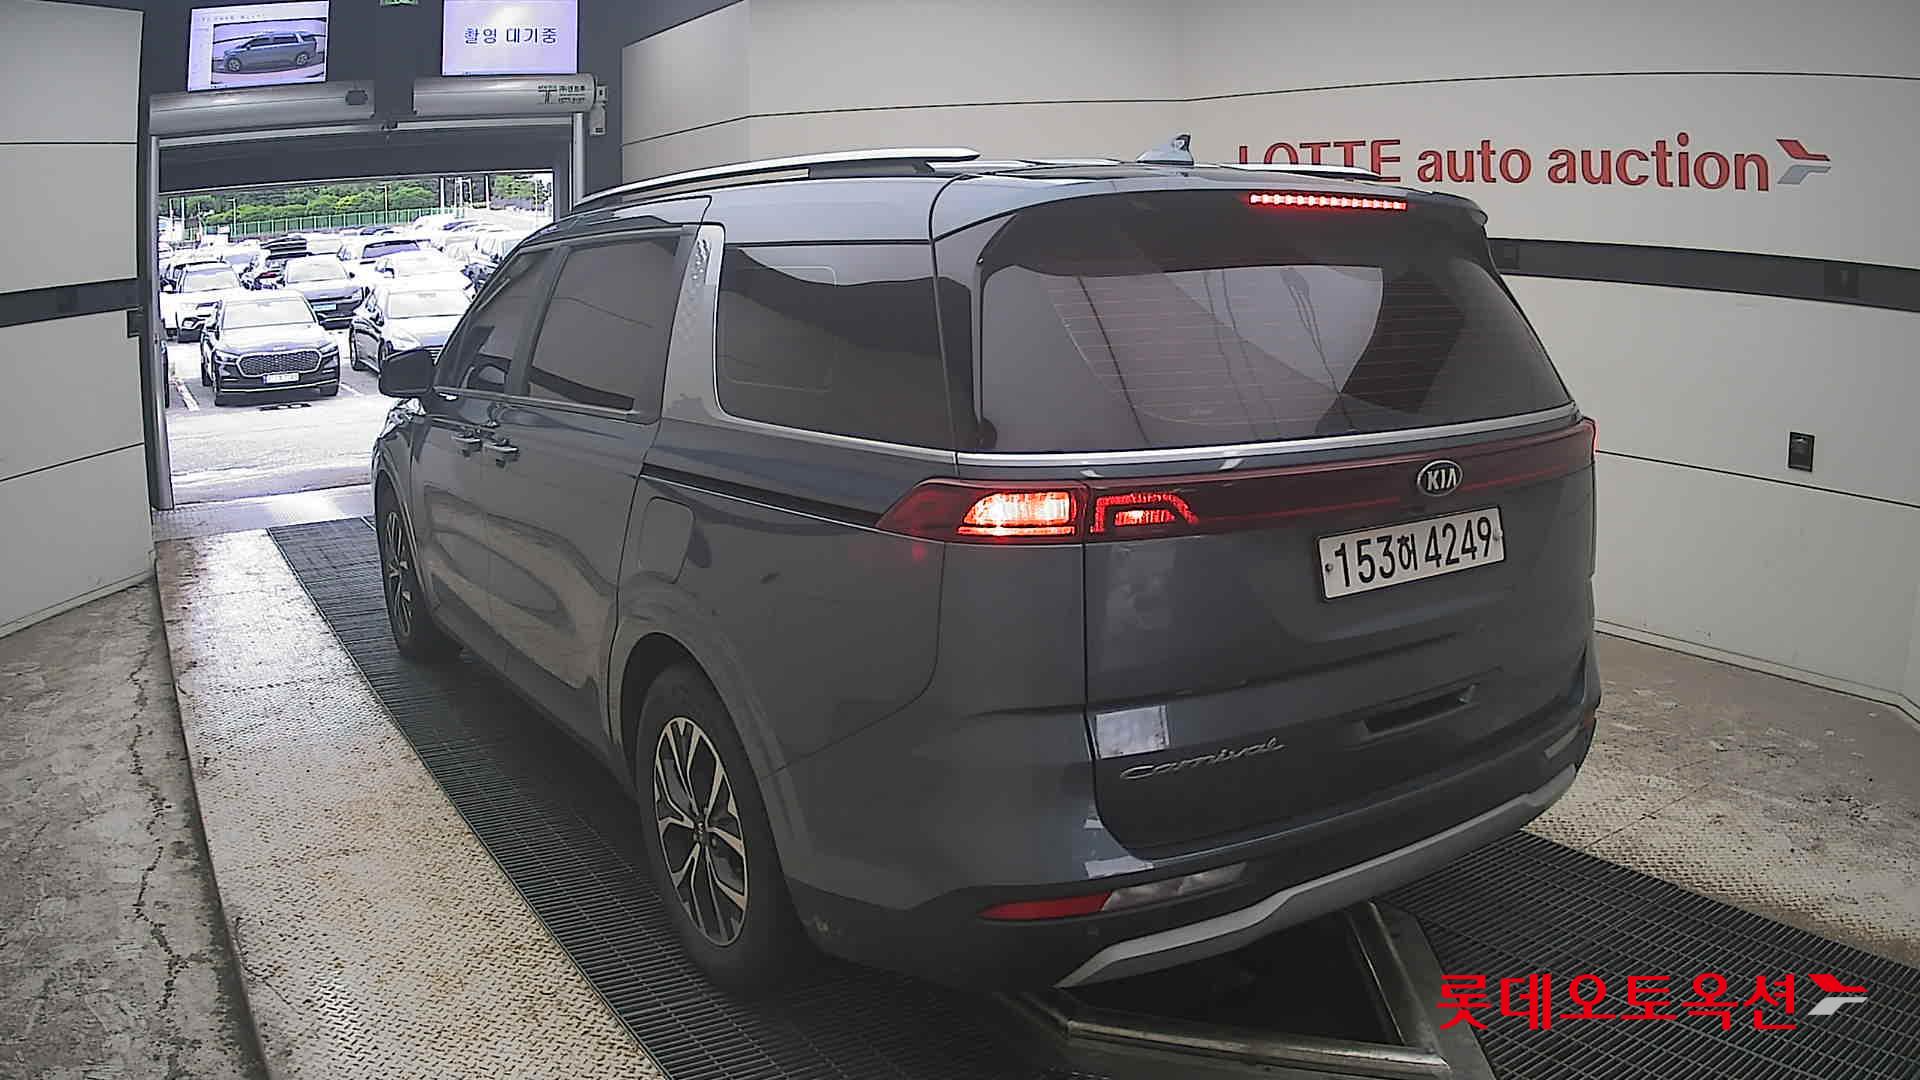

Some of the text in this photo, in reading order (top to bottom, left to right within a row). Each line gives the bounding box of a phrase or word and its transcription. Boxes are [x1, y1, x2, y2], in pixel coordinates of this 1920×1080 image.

[465, 28, 556, 44] 촬영 대기중
[1417, 139, 1532, 184] auto
[1548, 132, 1770, 192] auction
[1427, 468, 1457, 490] KIA
[1335, 516, 1492, 587] 153허 4249
[1120, 736, 1286, 780] Carnival
